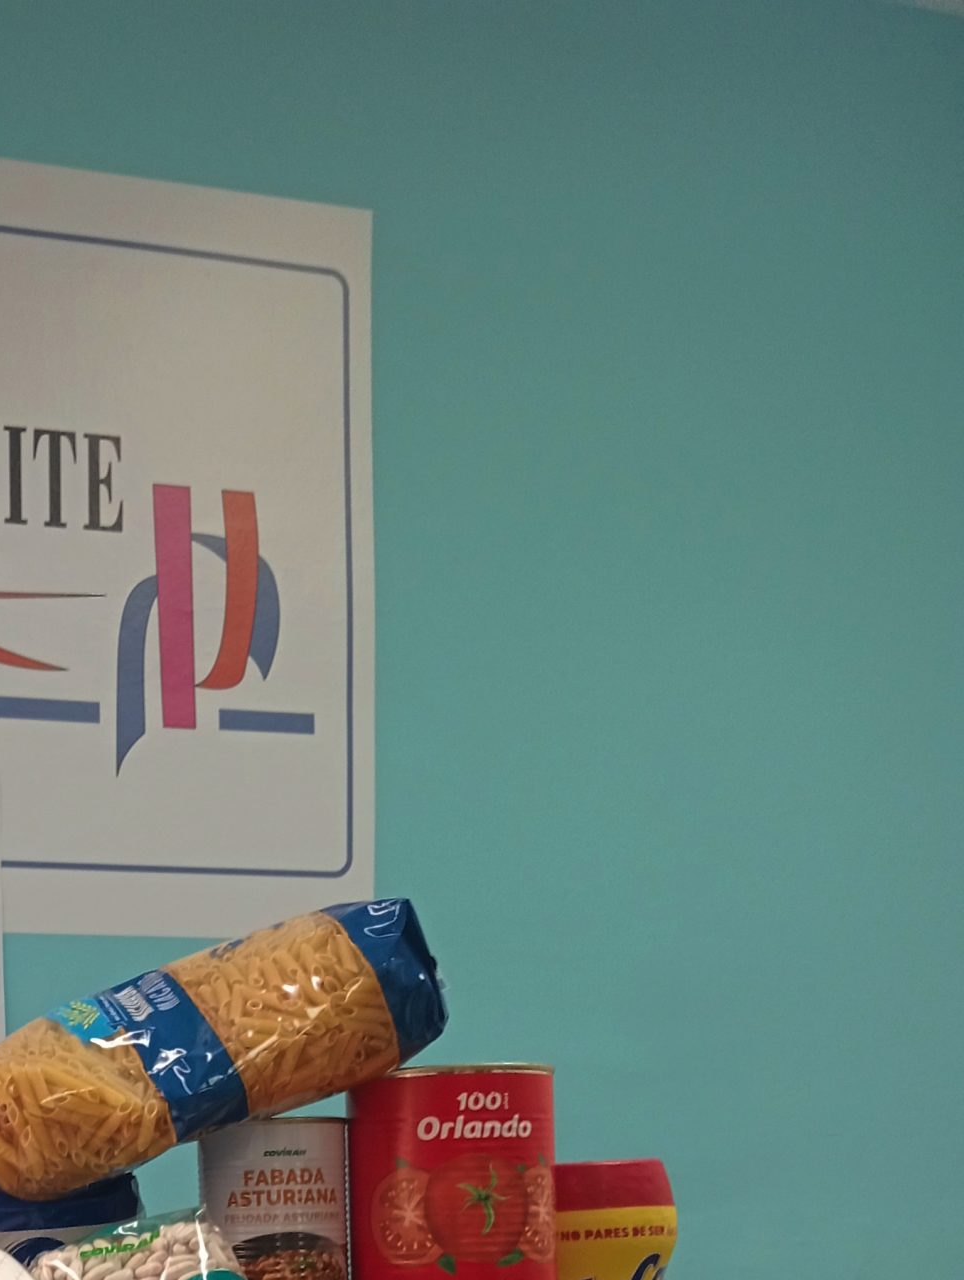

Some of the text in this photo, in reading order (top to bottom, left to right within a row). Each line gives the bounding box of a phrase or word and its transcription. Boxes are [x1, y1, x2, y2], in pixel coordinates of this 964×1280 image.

[456, 1091, 502, 1112] 100
[417, 1113, 532, 1140] Orlando
[242, 1168, 324, 1186] FABADA
[227, 1187, 337, 1208] ASTURIANA
[560, 1225, 665, 1242] NO PARES DE SER
